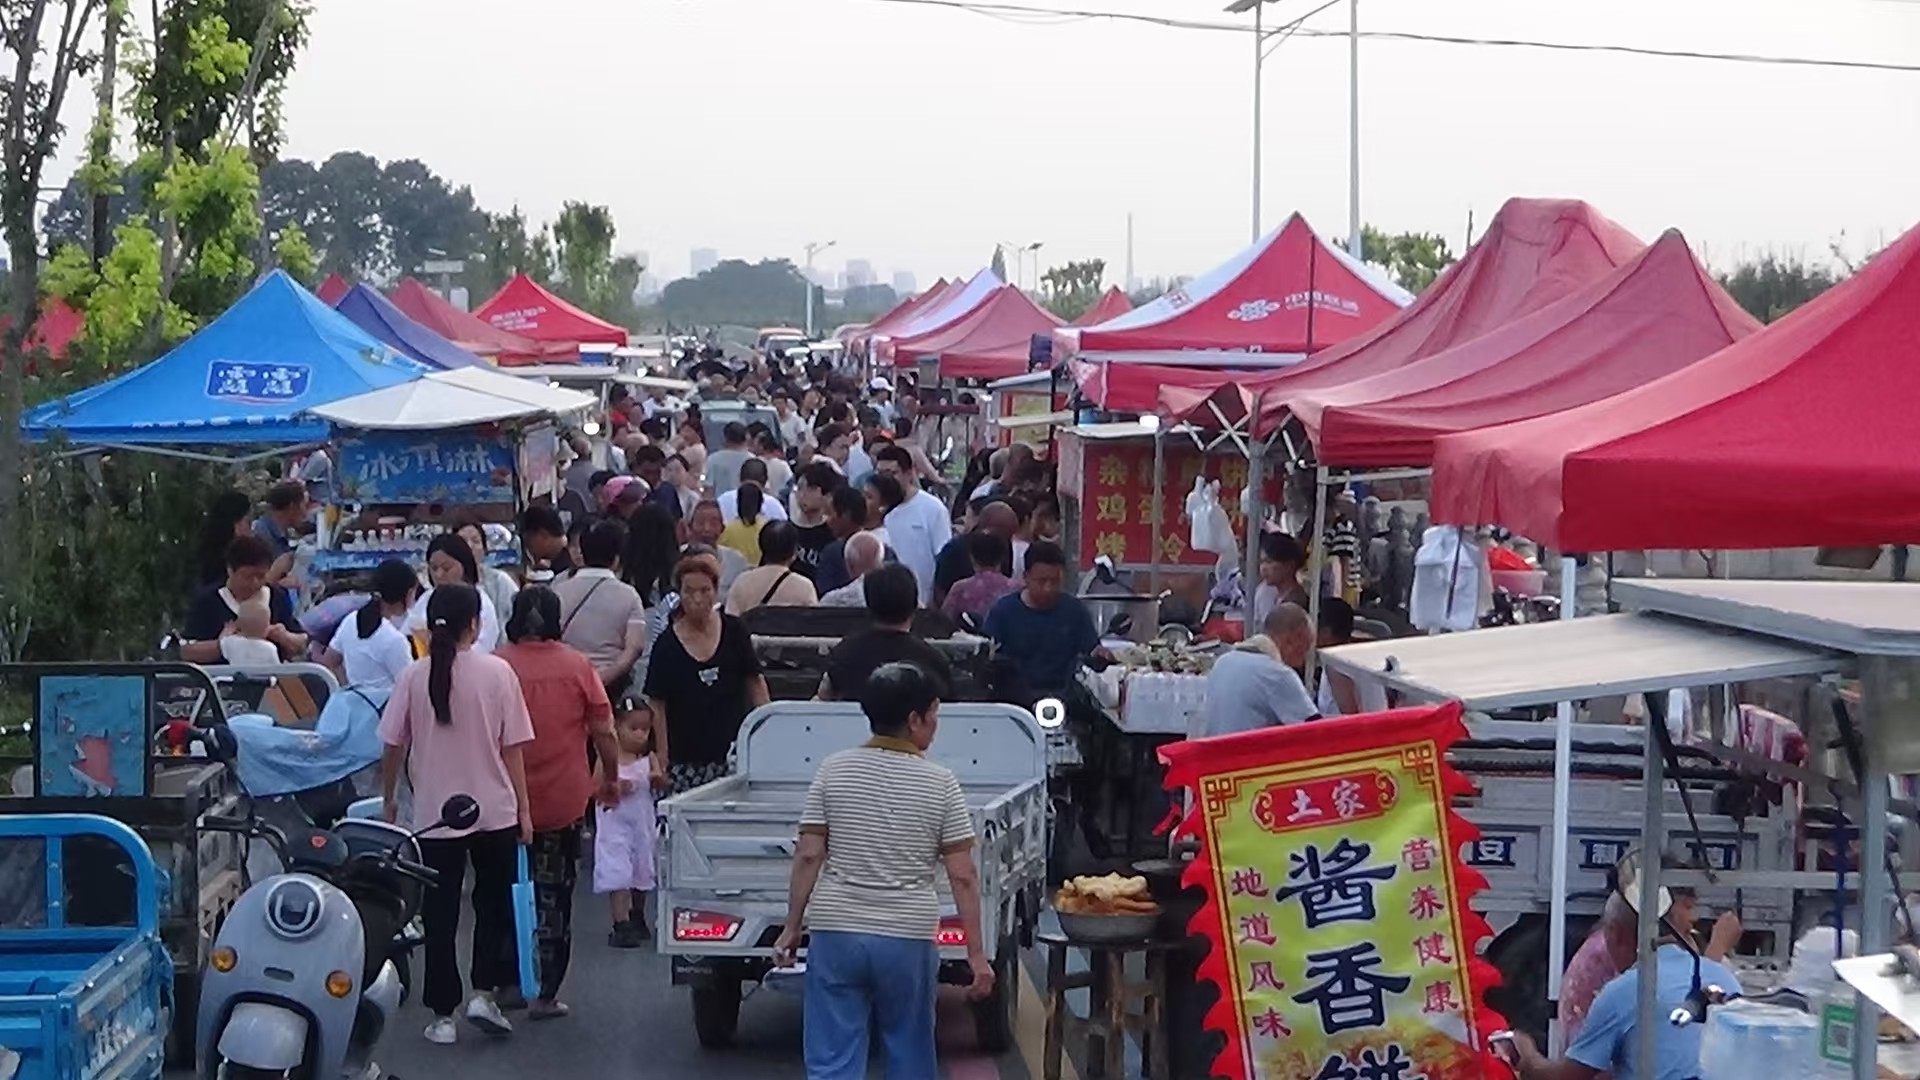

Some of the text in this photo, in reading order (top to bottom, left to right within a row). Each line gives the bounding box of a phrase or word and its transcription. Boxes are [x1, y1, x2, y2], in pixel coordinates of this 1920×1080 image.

[1286, 779, 1366, 823] 土家
[1231, 866, 1291, 1040] 地道风味
[1402, 836, 1459, 1015] 营养健康
